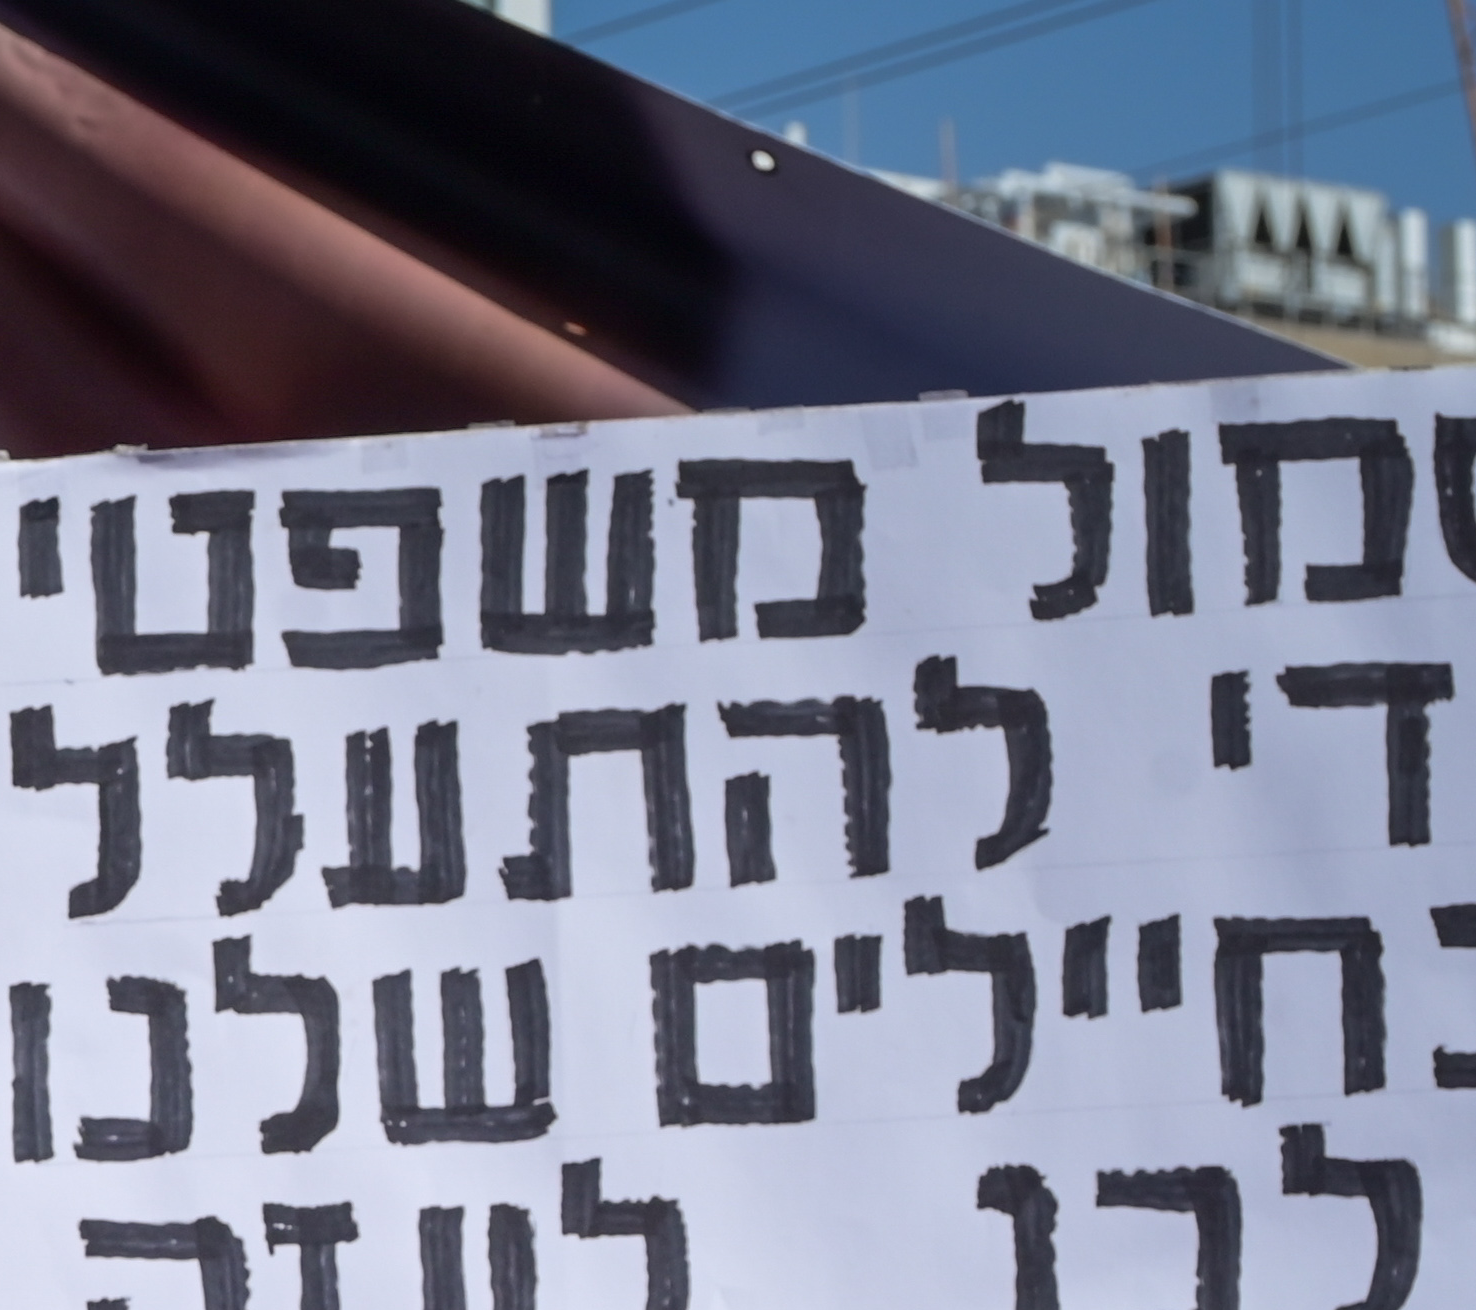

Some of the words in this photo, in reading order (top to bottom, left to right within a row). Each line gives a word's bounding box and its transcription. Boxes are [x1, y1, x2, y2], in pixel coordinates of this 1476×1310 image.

[19, 459, 866, 675] משפטי
[10, 655, 1052, 918] להתעלל
[1211, 662, 1454, 847] די
[10, 936, 556, 1162] שלנו
